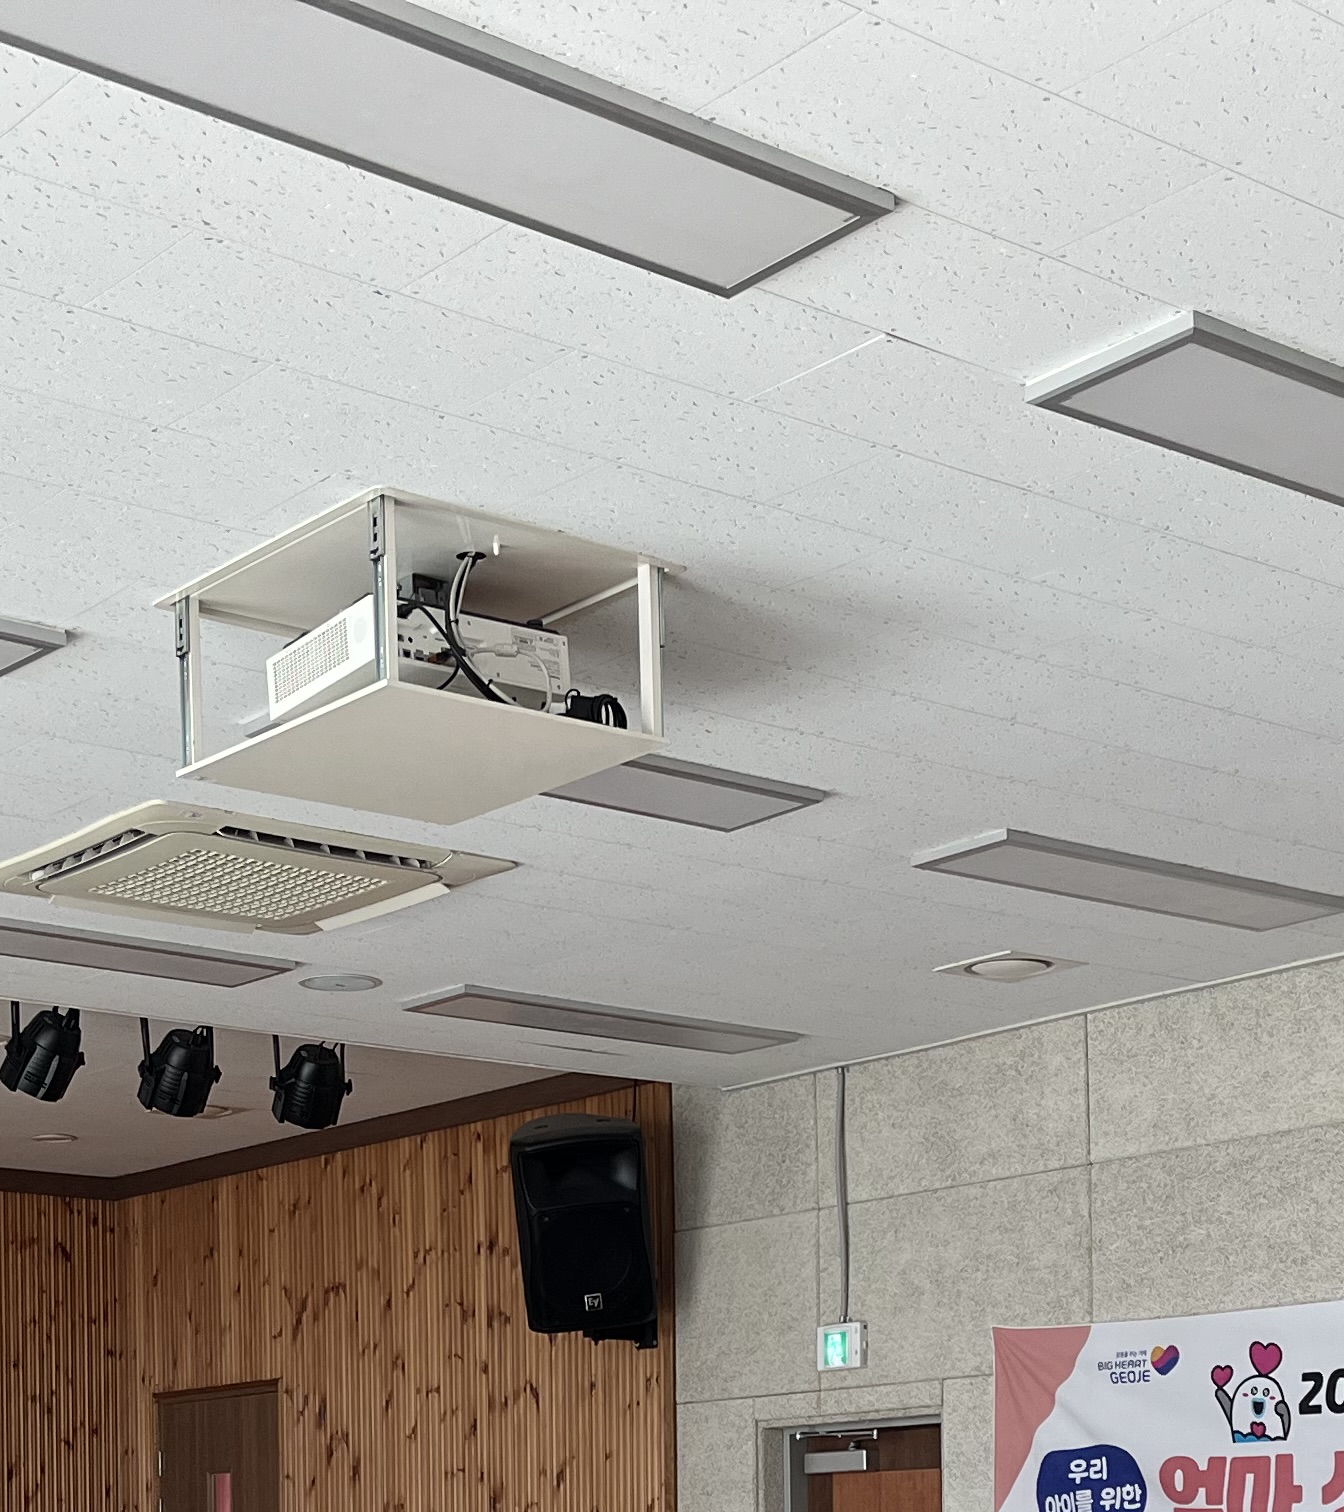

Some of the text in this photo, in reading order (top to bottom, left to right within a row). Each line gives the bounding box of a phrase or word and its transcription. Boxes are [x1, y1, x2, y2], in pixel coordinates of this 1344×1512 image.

[1097, 1359, 1147, 1371] BIG HEART
[1110, 1369, 1151, 1384] GEOJE
[1068, 1456, 1108, 1485] 우리
[1099, 1483, 1142, 1511] 위한
